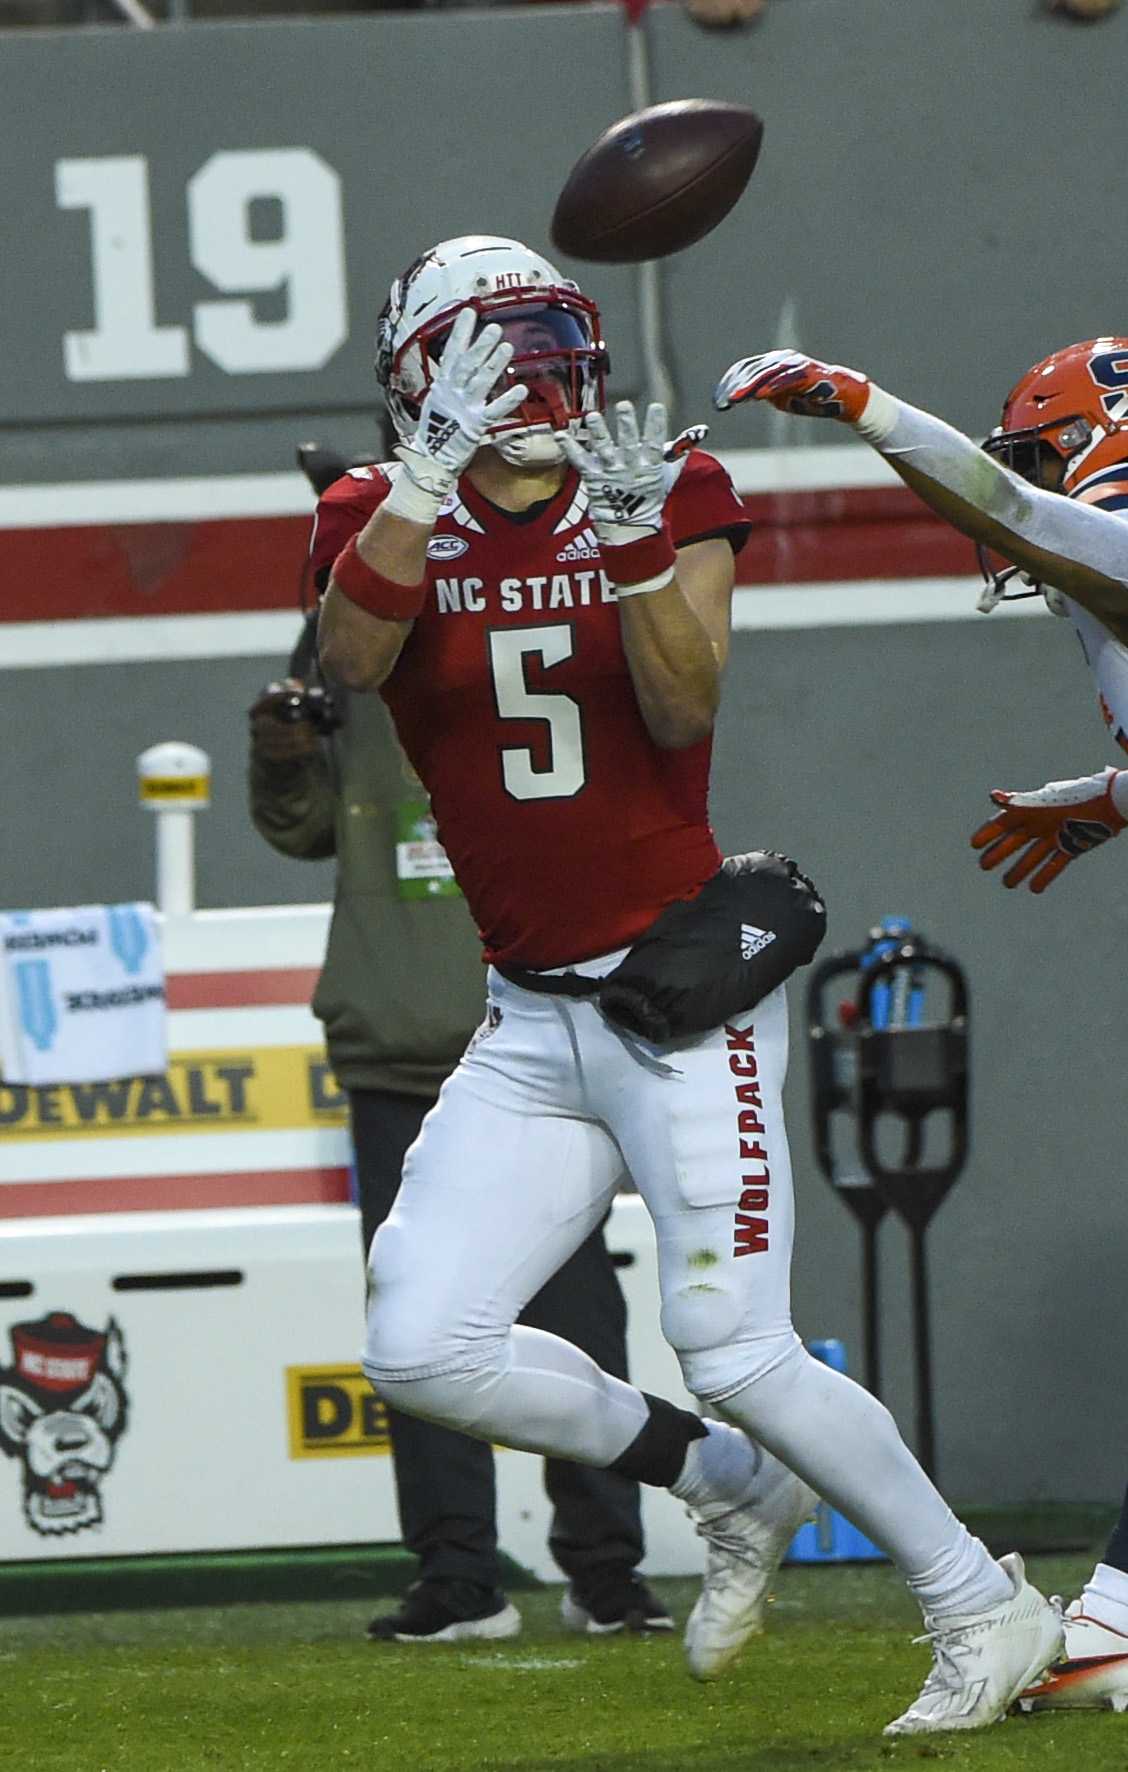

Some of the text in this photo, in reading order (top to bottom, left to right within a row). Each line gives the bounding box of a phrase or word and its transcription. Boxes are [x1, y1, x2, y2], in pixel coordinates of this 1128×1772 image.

[55, 146, 349, 382] 19
[495, 272, 522, 290] HTT
[556, 545, 601, 562] adida
[435, 568, 619, 614] NC STATE
[487, 621, 588, 803] 5
[741, 930, 777, 961] adidas
[724, 1022, 771, 1258] WOLFPACK
